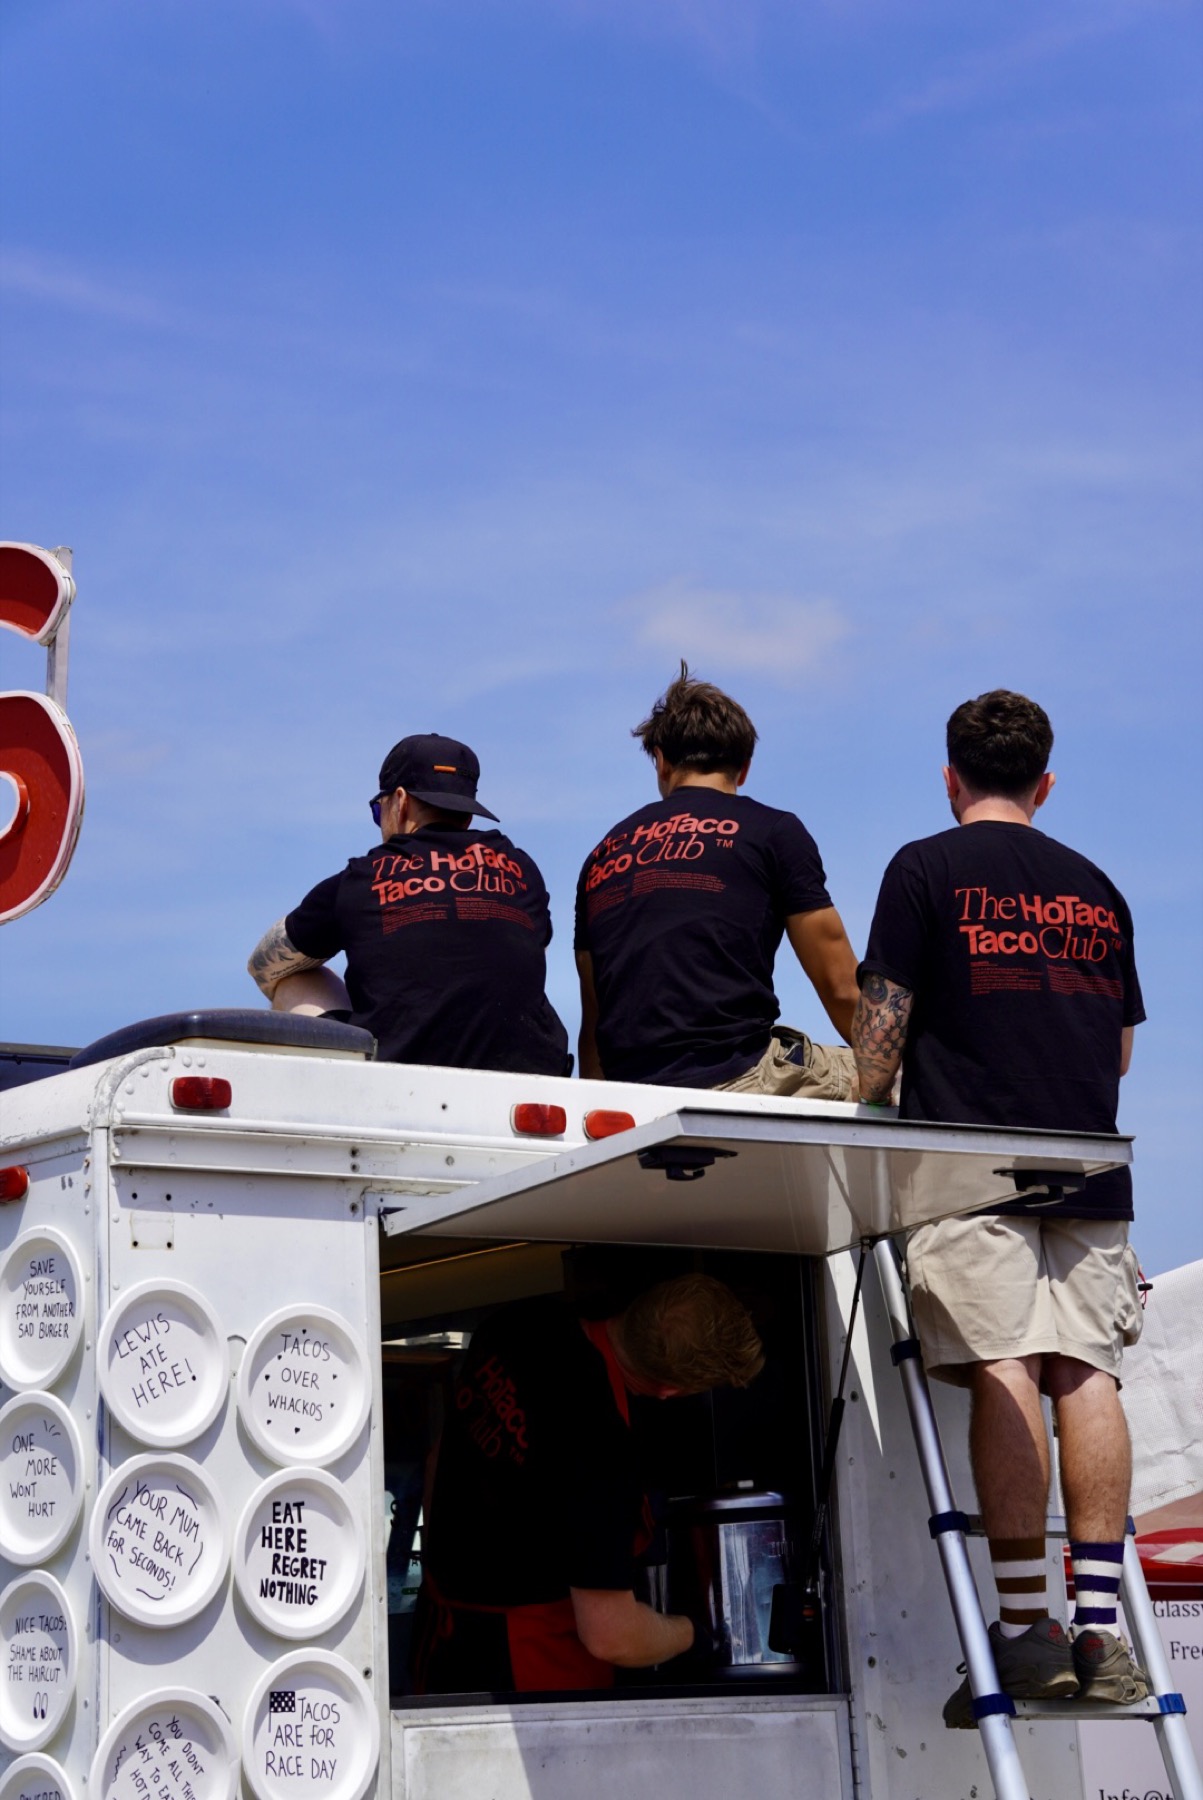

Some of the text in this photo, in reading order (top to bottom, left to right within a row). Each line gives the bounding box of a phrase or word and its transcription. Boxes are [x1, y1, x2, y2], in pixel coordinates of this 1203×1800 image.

[631, 813, 739, 845] HoTaco
[372, 843, 523, 882] The HoTaco
[636, 833, 704, 865] Club
[371, 876, 446, 905] Taco
[450, 865, 516, 896] Club
[955, 887, 1120, 934] The HoTaco
[959, 924, 1038, 955] Taco
[1038, 926, 1107, 962] Club
[30, 1258, 55, 1277] SAVE
[23, 1279, 66, 1300] YOURSELF
[16, 1302, 75, 1320] FROM ANOTHER
[18, 1322, 69, 1339] SAD BURGER
[115, 1313, 170, 1359] LEWIS
[140, 1343, 167, 1375] ATE
[281, 1333, 330, 1361] TACOS
[132, 1358, 196, 1408] HERE!
[281, 1367, 320, 1390] OVER
[268, 1391, 323, 1421] WHACKOS
[12, 1433, 35, 1454] ONE
[25, 1457, 57, 1476] MORE
[10, 1481, 37, 1498] WONT
[28, 1502, 55, 1517] HURT
[131, 1480, 199, 1543] YOUR MUM
[272, 1501, 305, 1524] EAT
[116, 1507, 183, 1567] CAME BACK
[262, 1526, 307, 1553] HERE
[129, 1546, 176, 1591] SECONDS!
[271, 1553, 327, 1581] REGRET
[260, 1578, 318, 1606] NOTHING
[1153, 1600, 1203, 1617] Glass
[15, 1617, 35, 1635] NICE
[10, 1643, 63, 1661] SHAME ABOUT
[1170, 1641, 1203, 1660] Fre
[8, 1664, 61, 1683] THE HAIRCUT
[297, 1696, 340, 1724] TACOS
[165, 1715, 205, 1775] YOU DIDNT
[273, 1724, 335, 1748] ARE FOR
[135, 1735, 153, 1764] WAY
[149, 1767, 161, 1784] TO
[148, 1722, 171, 1756] COME
[168, 1760, 183, 1782] ALL
[265, 1751, 337, 1780] RACE DAY
[130, 1768, 148, 1794] HOT
